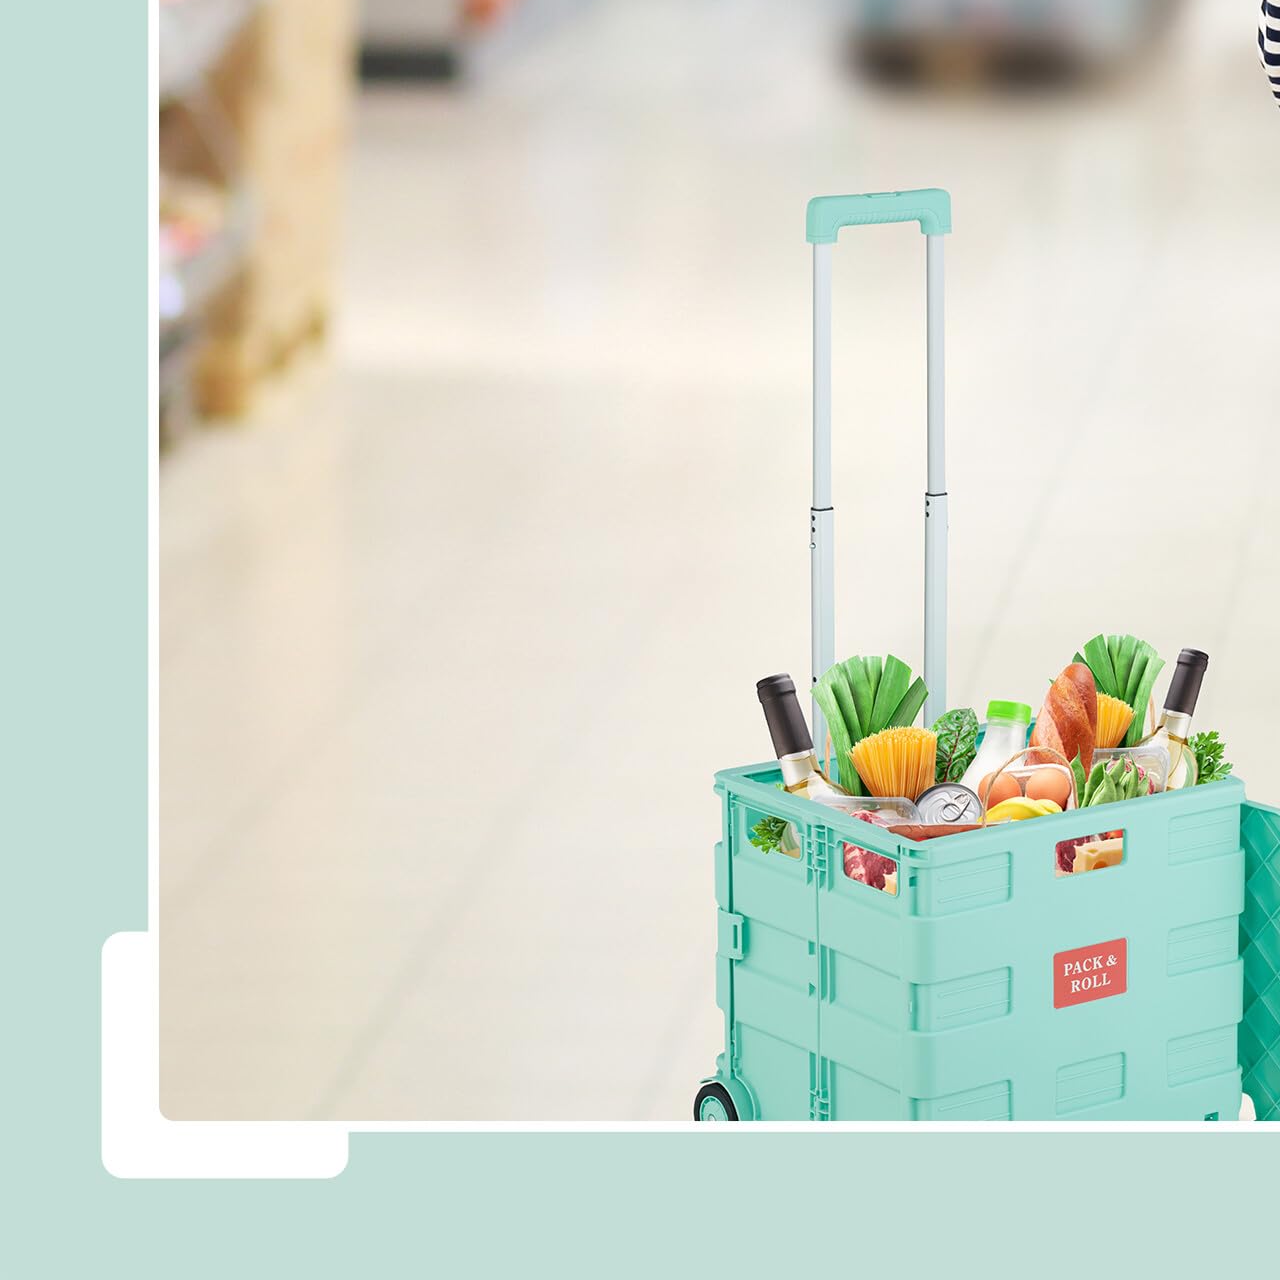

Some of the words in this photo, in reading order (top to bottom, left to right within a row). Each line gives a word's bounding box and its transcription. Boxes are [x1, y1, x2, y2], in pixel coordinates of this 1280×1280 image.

[1063, 955, 1103, 976] PACK
[1106, 954, 1117, 967] &
[1071, 972, 1111, 993] ROLL
